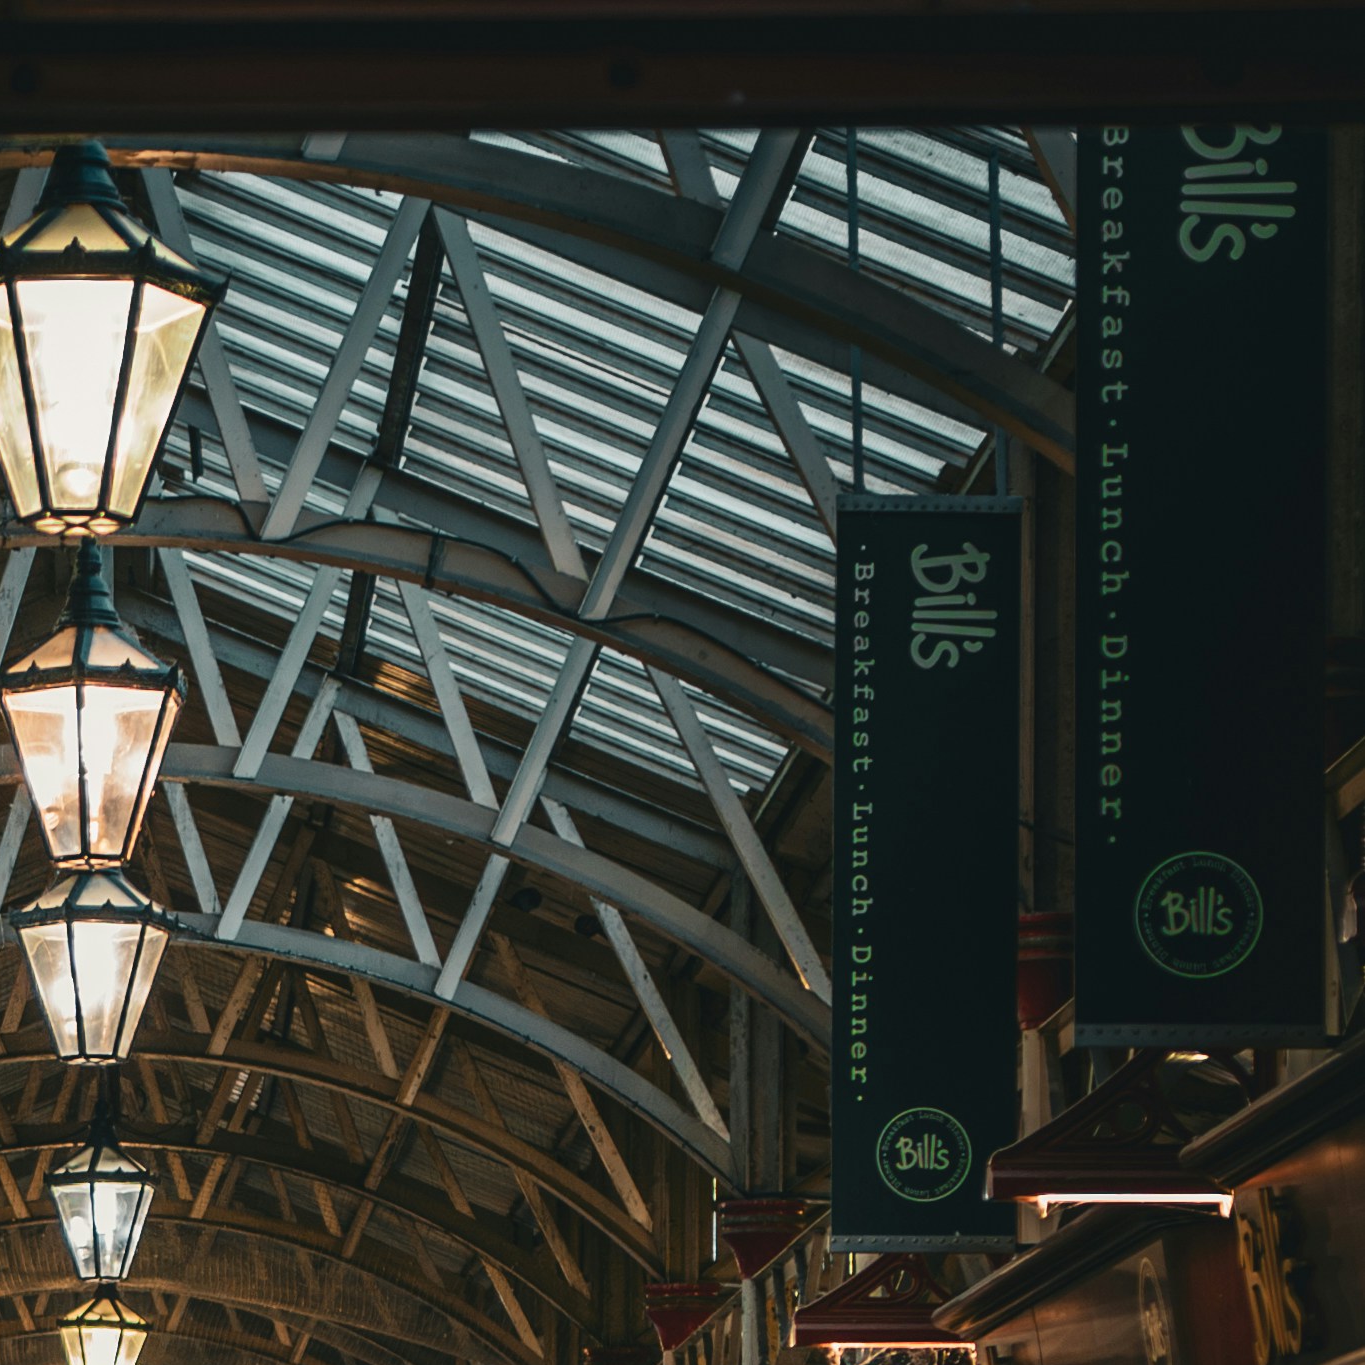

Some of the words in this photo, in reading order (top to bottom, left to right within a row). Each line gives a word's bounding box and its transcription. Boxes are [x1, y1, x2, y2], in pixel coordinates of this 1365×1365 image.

[1101, 442, 1129, 595] Lunch
[910, 541, 998, 669] Bill's
[852, 562, 875, 772] Breakfast
[851, 802, 873, 917] Lunch
[1160, 885, 1234, 936] Bill's
[895, 1133, 950, 1171] Bill's
